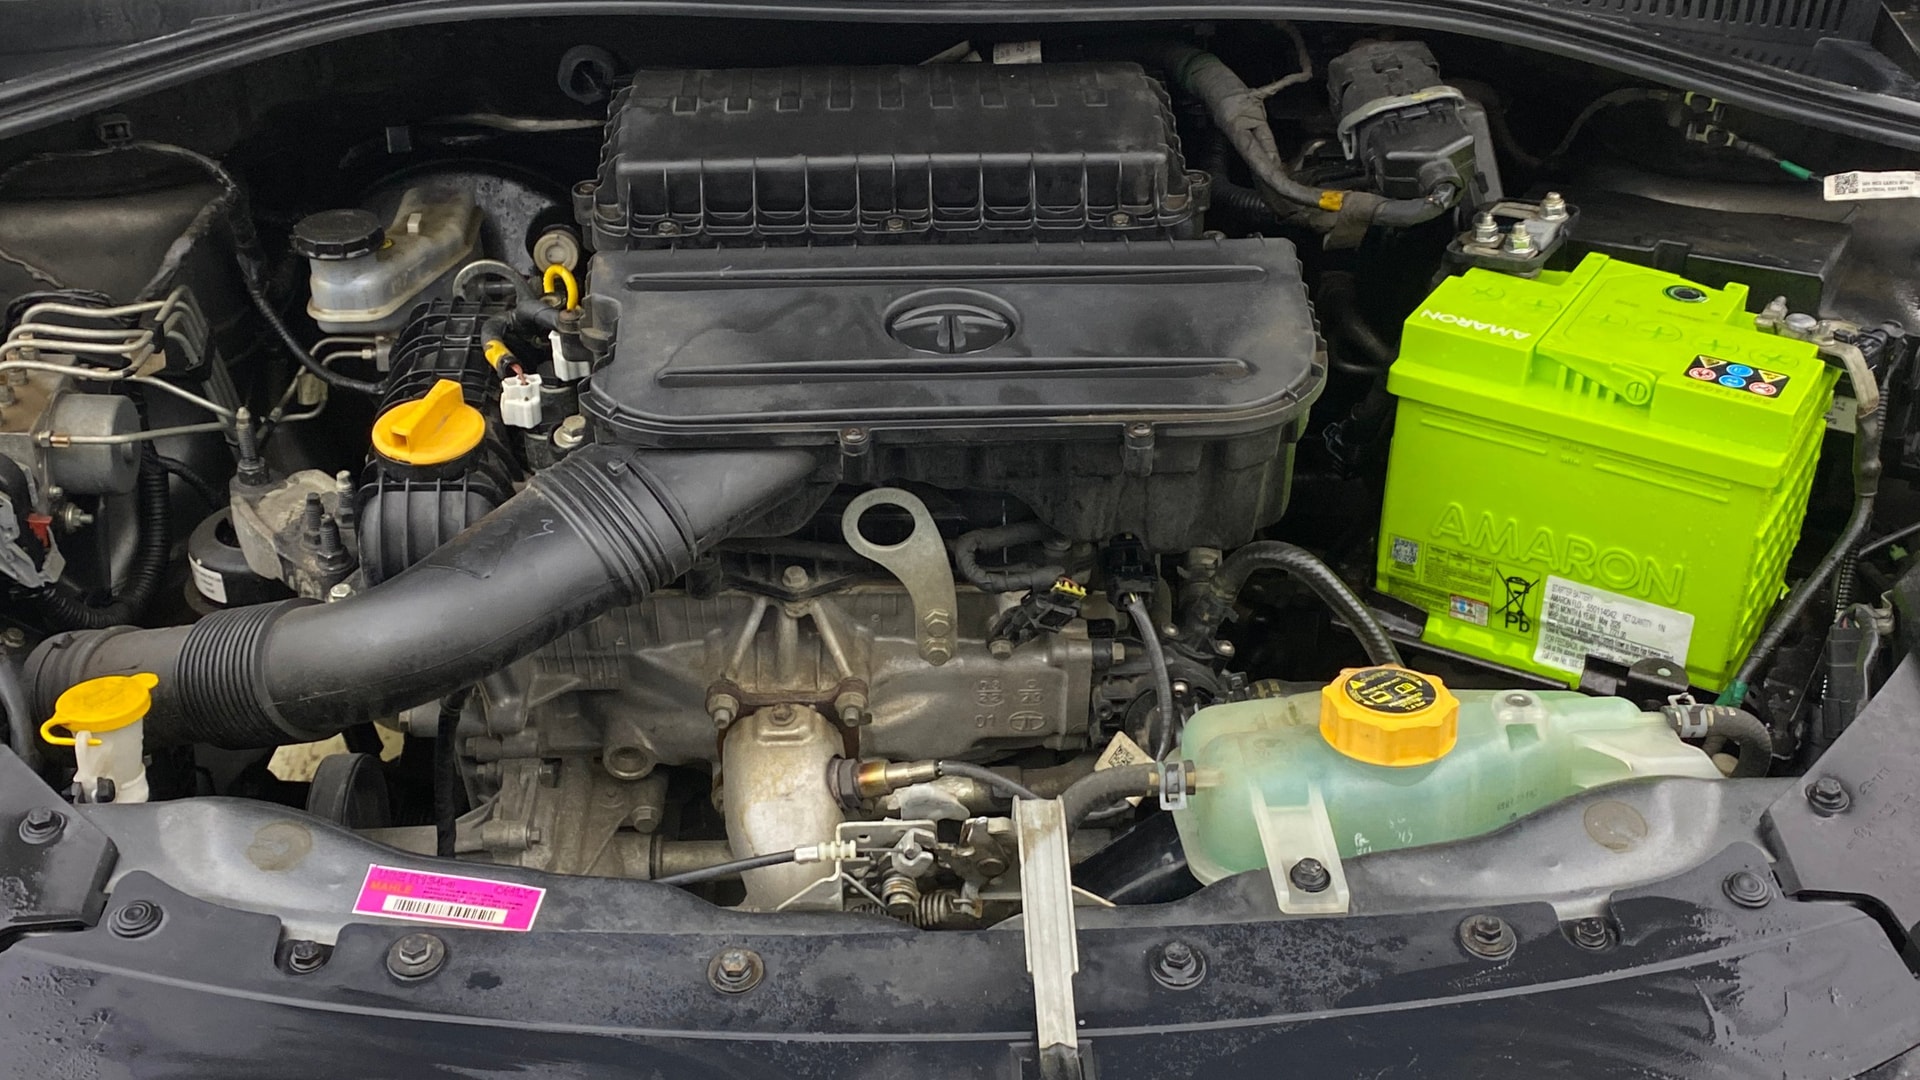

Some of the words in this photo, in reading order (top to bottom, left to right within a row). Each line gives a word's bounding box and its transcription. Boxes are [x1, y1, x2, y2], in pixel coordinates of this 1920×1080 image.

[1420, 309, 1531, 340] AMARON
[1431, 502, 1684, 605] AMARON
[1550, 593, 1571, 605] AMARON
[1505, 613, 1530, 633] Pb
[369, 881, 414, 895] MAHLE
